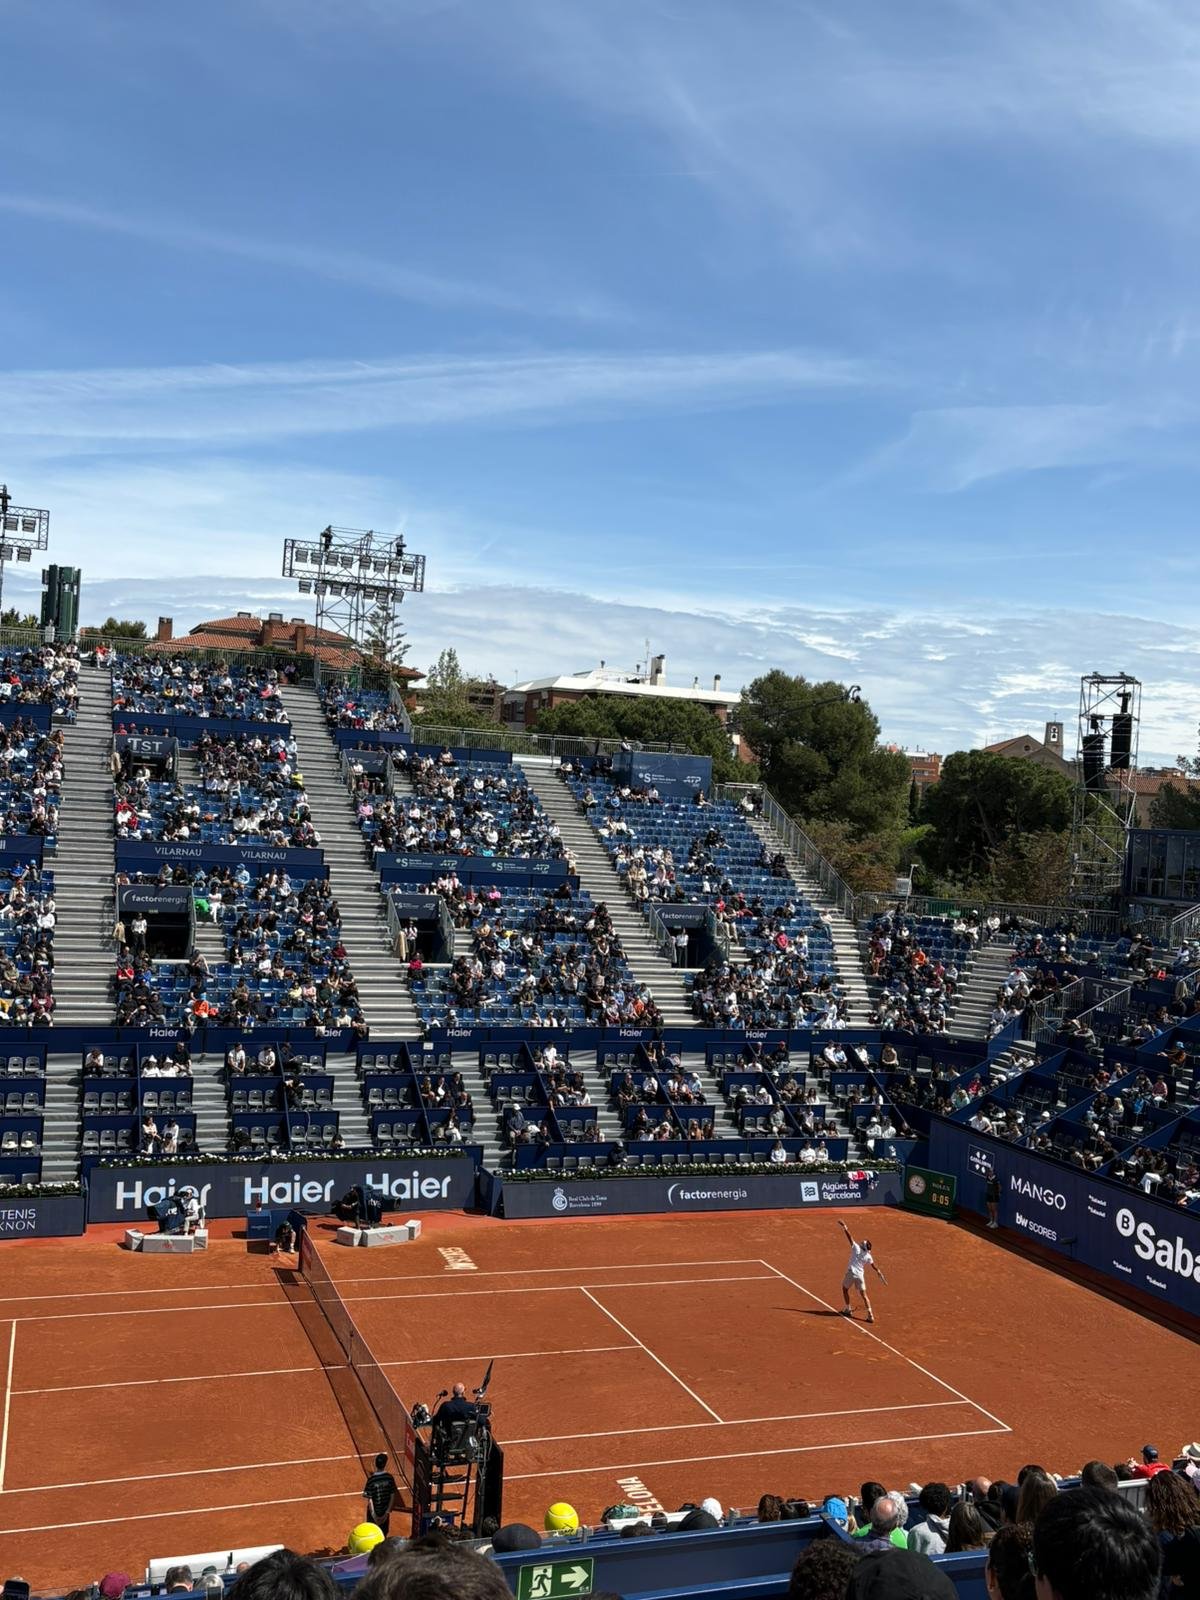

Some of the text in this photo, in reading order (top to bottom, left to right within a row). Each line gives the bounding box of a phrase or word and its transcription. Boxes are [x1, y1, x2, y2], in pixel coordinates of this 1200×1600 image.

[127, 738, 163, 752] TST
[154, 847, 202, 857] VILARNAU
[241, 851, 287, 860] VILARNAU
[150, 1028, 178, 1037] Haier
[447, 1028, 472, 1037] Haier
[620, 1028, 642, 1037] Haier
[745, 1030, 767, 1039] Haier
[244, 1174, 335, 1205] Haier
[364, 1170, 451, 1200] Haier
[680, 1188, 748, 1201] factorenergia
[823, 1191, 861, 1200] Barcelona
[1011, 1175, 1066, 1210] MANGO
[0, 1208, 36, 1220] TENIS
[1029, 1220, 1057, 1241] SCORES
